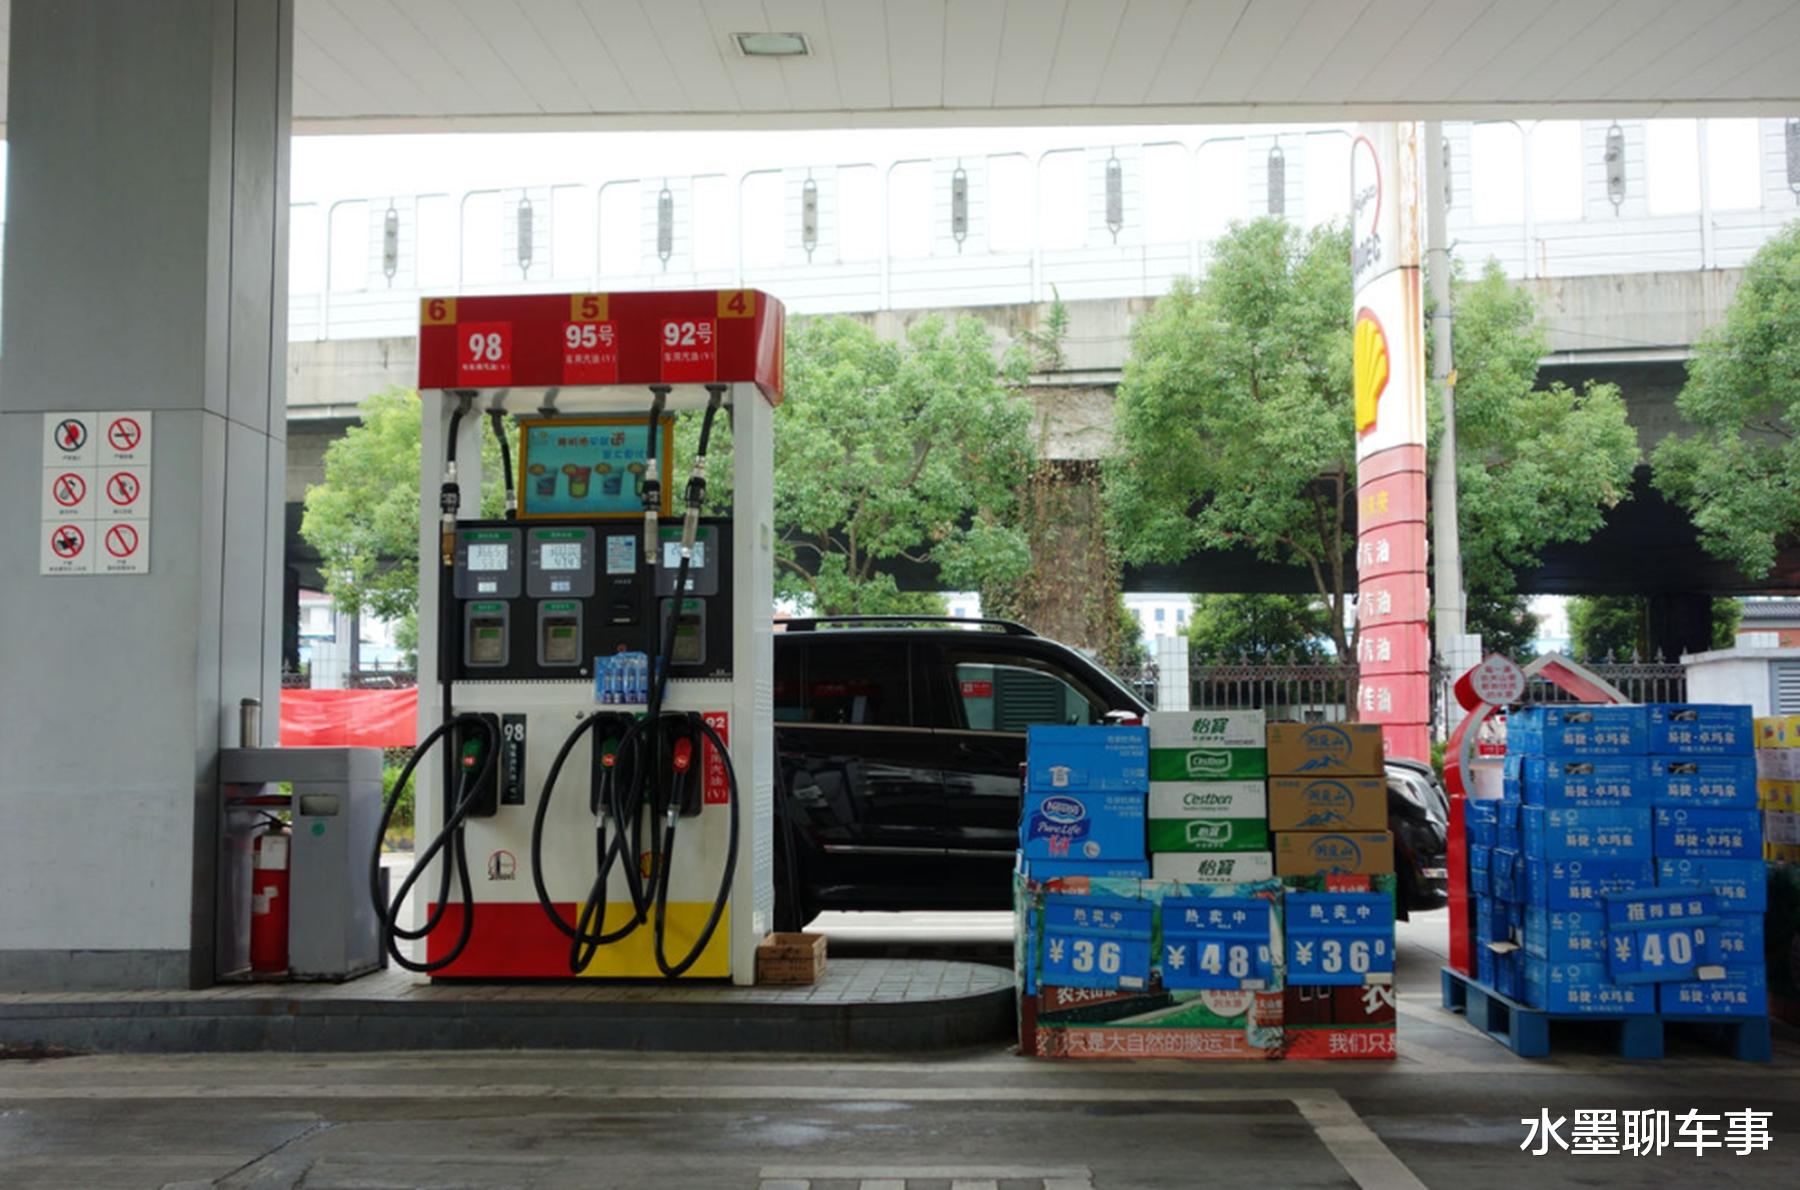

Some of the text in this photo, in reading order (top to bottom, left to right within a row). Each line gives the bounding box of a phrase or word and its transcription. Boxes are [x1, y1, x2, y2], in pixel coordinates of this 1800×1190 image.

[428, 299, 446, 321] 6
[581, 297, 599, 319] 5
[727, 291, 747, 315] 4
[566, 324, 615, 349] 95号
[664, 321, 713, 346] 92号
[469, 333, 502, 361] 98
[504, 723, 524, 741] 98
[705, 716, 725, 729] 92
